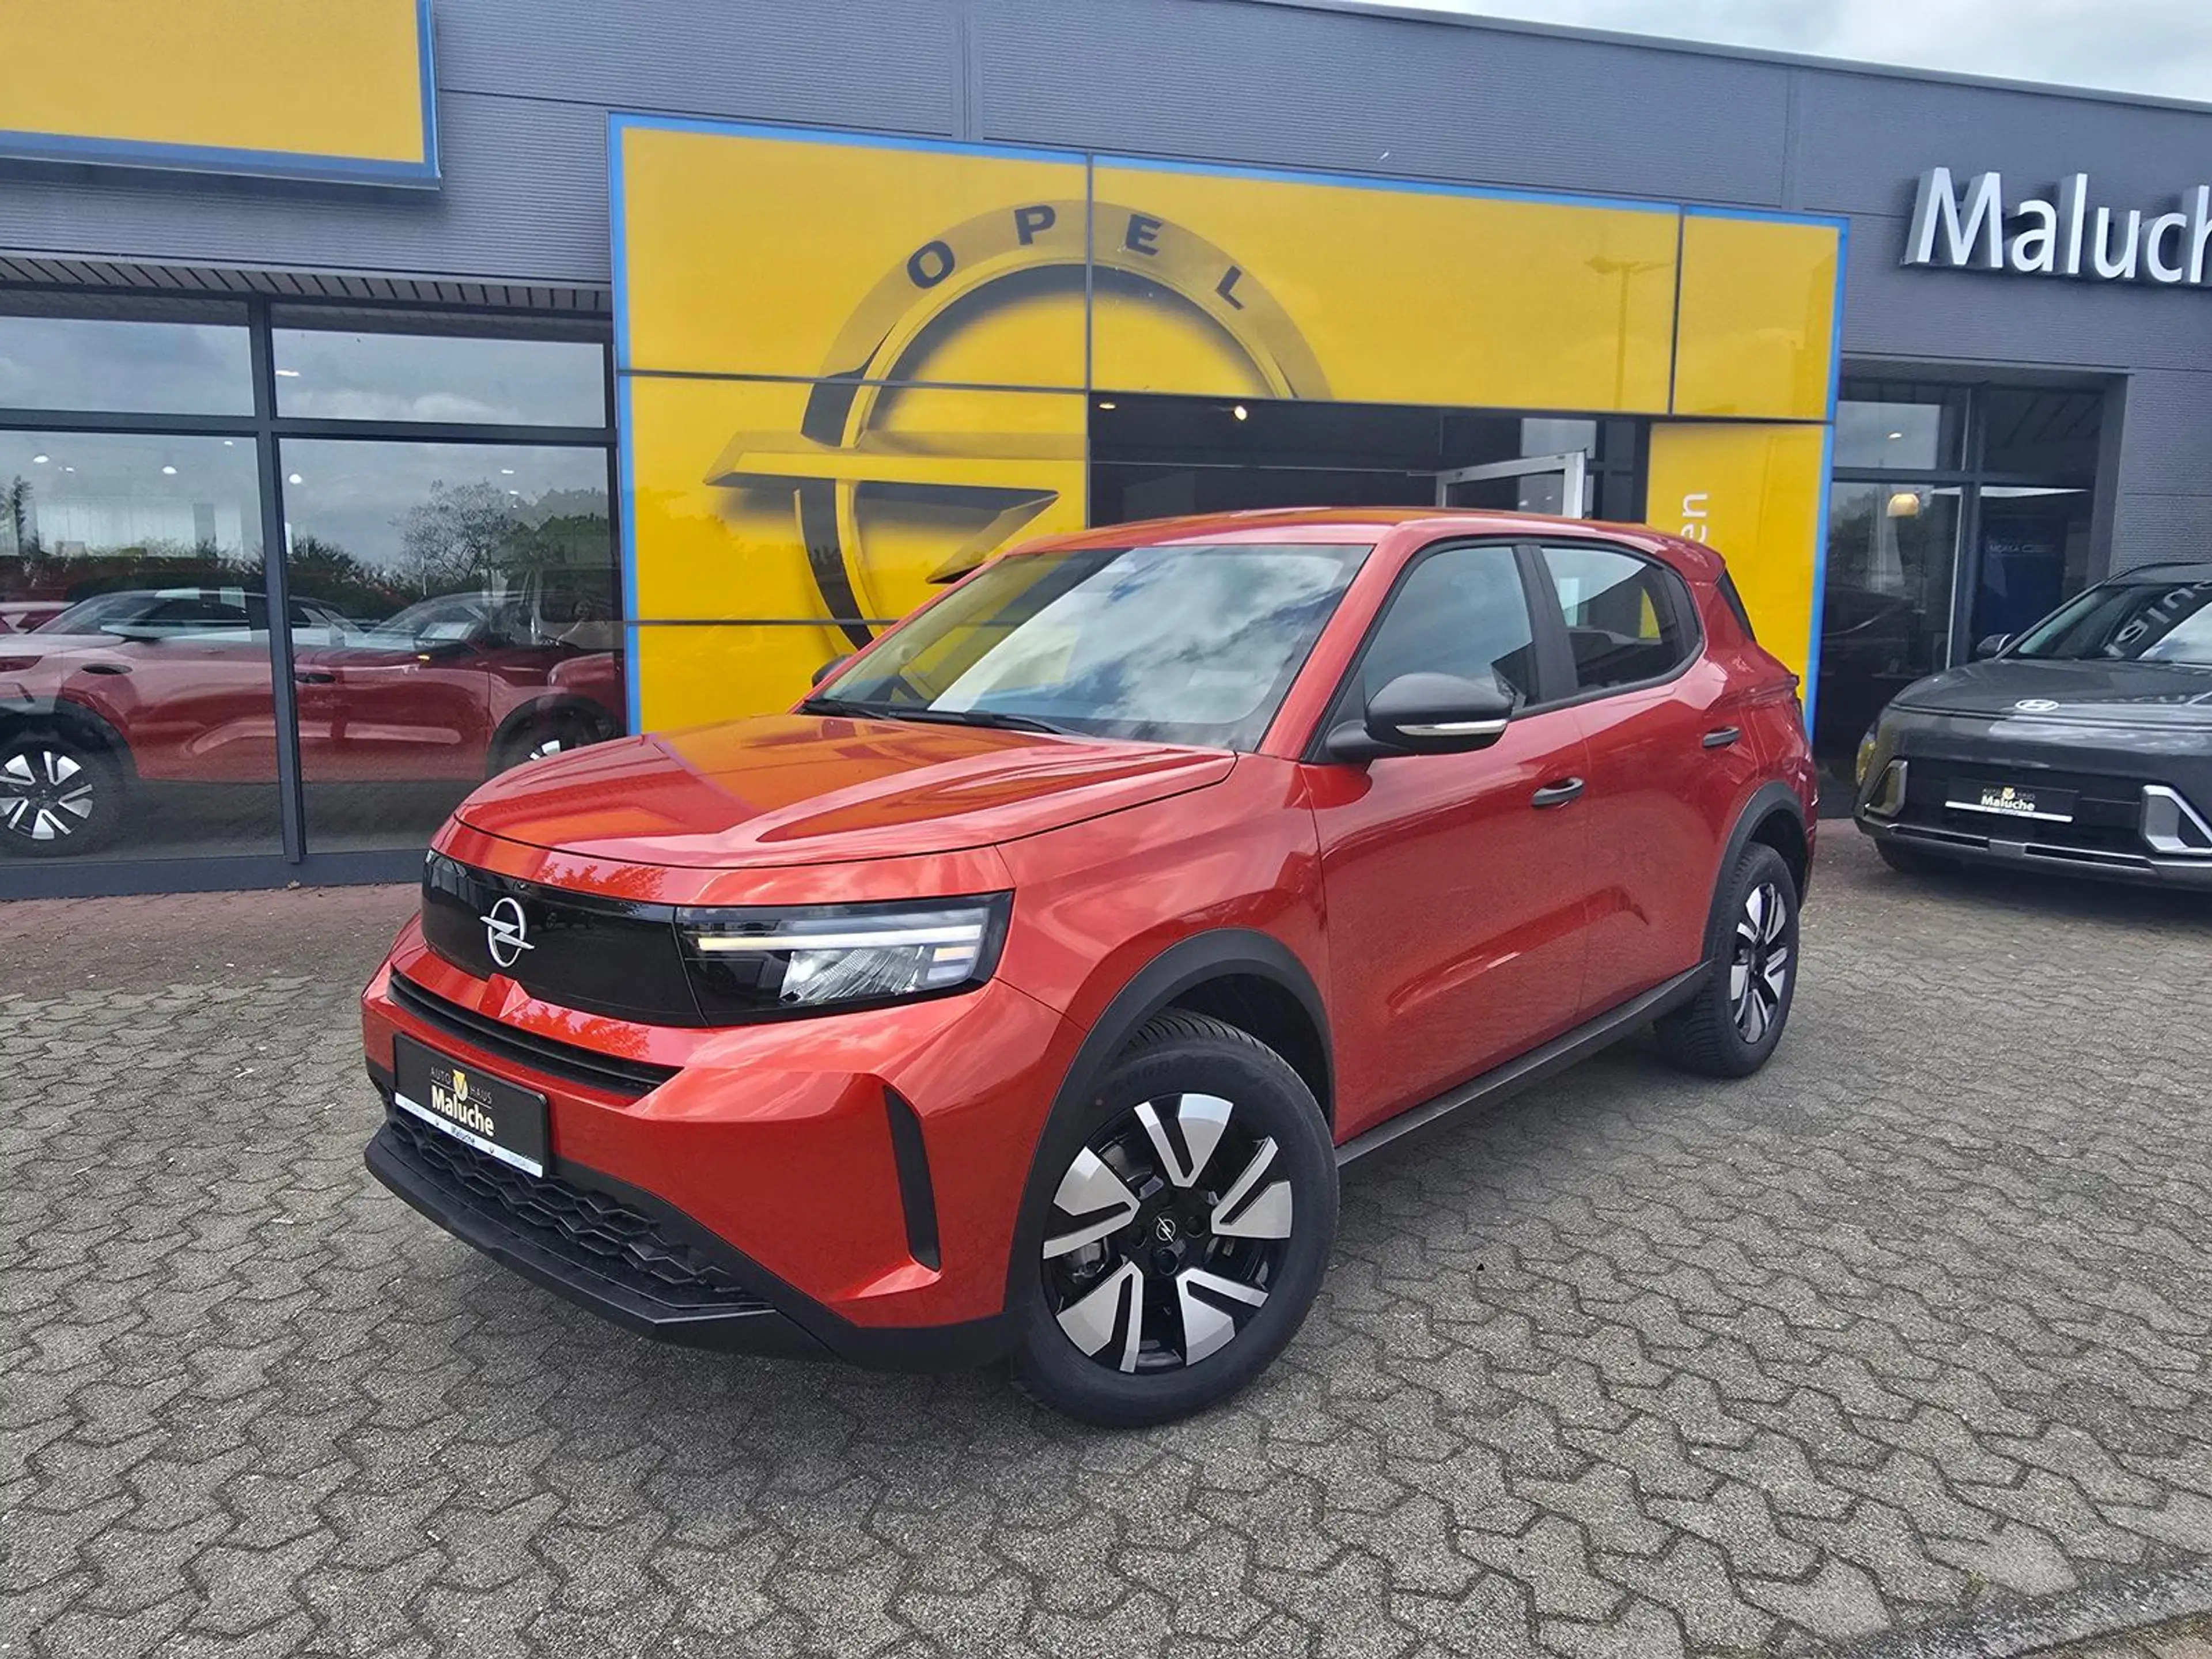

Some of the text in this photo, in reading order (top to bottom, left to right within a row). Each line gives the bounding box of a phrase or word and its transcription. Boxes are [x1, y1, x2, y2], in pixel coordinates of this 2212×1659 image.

[907, 204, 1245, 310] OPEL
[1982, 796, 2035, 811] Maluche
[430, 1067, 493, 1104] AUTO HAUS
[431, 1085, 495, 1137] Maluche
